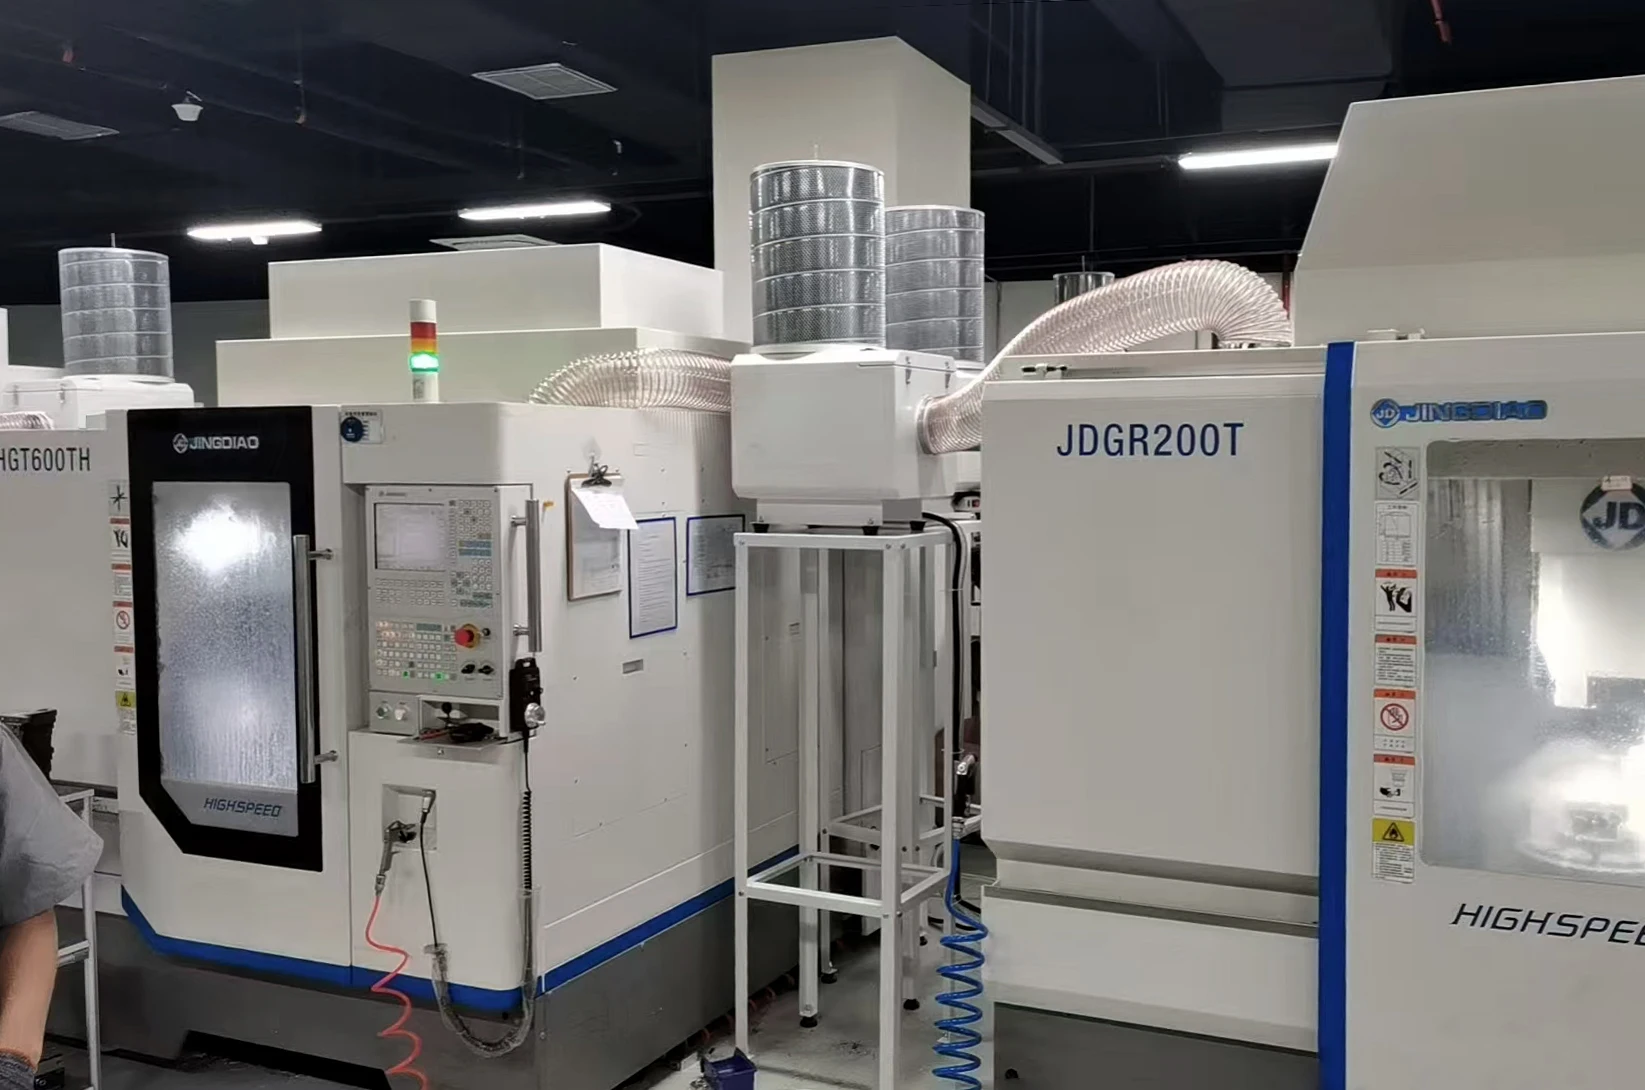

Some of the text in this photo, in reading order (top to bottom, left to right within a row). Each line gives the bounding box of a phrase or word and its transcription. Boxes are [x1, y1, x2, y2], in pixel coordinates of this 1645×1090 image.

[189, 436, 259, 449] JINGDIAO
[1057, 422, 1244, 456] JDGR200T
[1592, 501, 1645, 530] JD
[203, 798, 282, 817] HIGHSPEED
